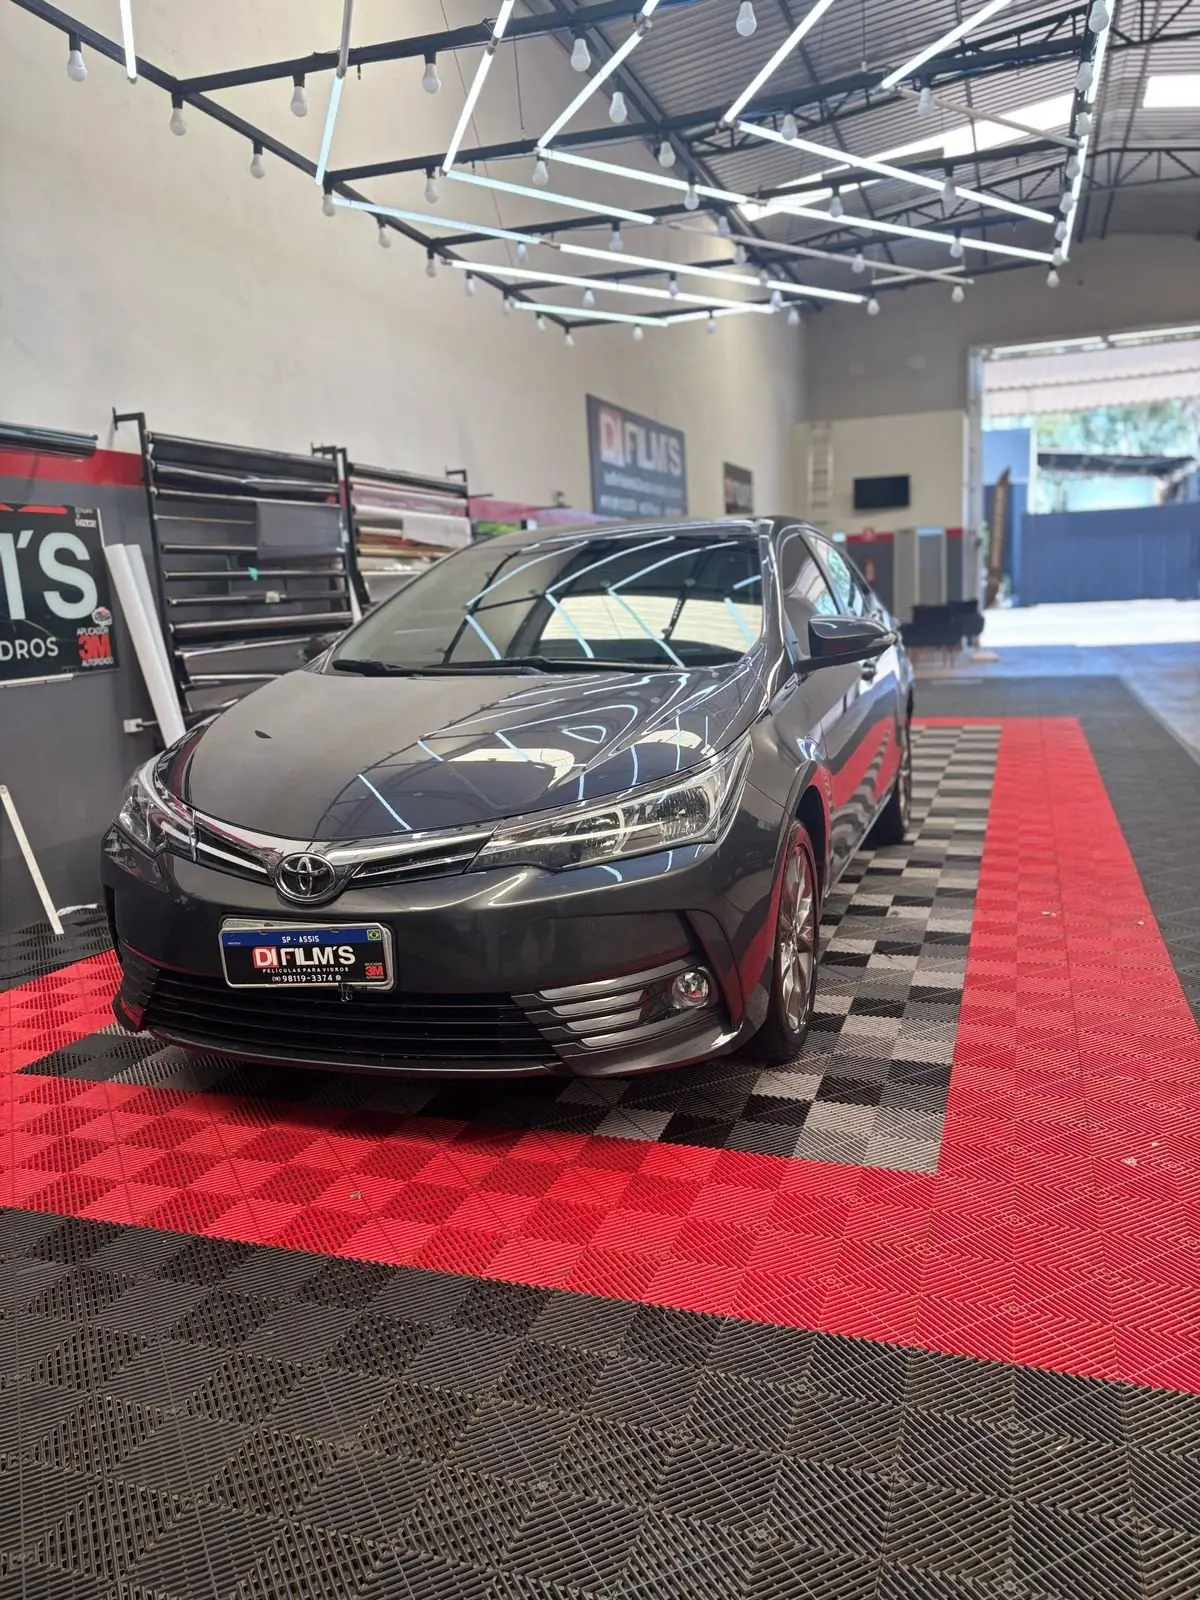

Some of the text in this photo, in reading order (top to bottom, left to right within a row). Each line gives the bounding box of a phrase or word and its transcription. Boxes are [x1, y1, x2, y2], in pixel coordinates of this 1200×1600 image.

[78, 634, 112, 660] 3M
[281, 936, 291, 944] SP
[298, 935, 320, 943] ASSIS
[254, 948, 278, 966] DI
[365, 966, 384, 976] 3M
[282, 974, 333, 982] 98119-3374
